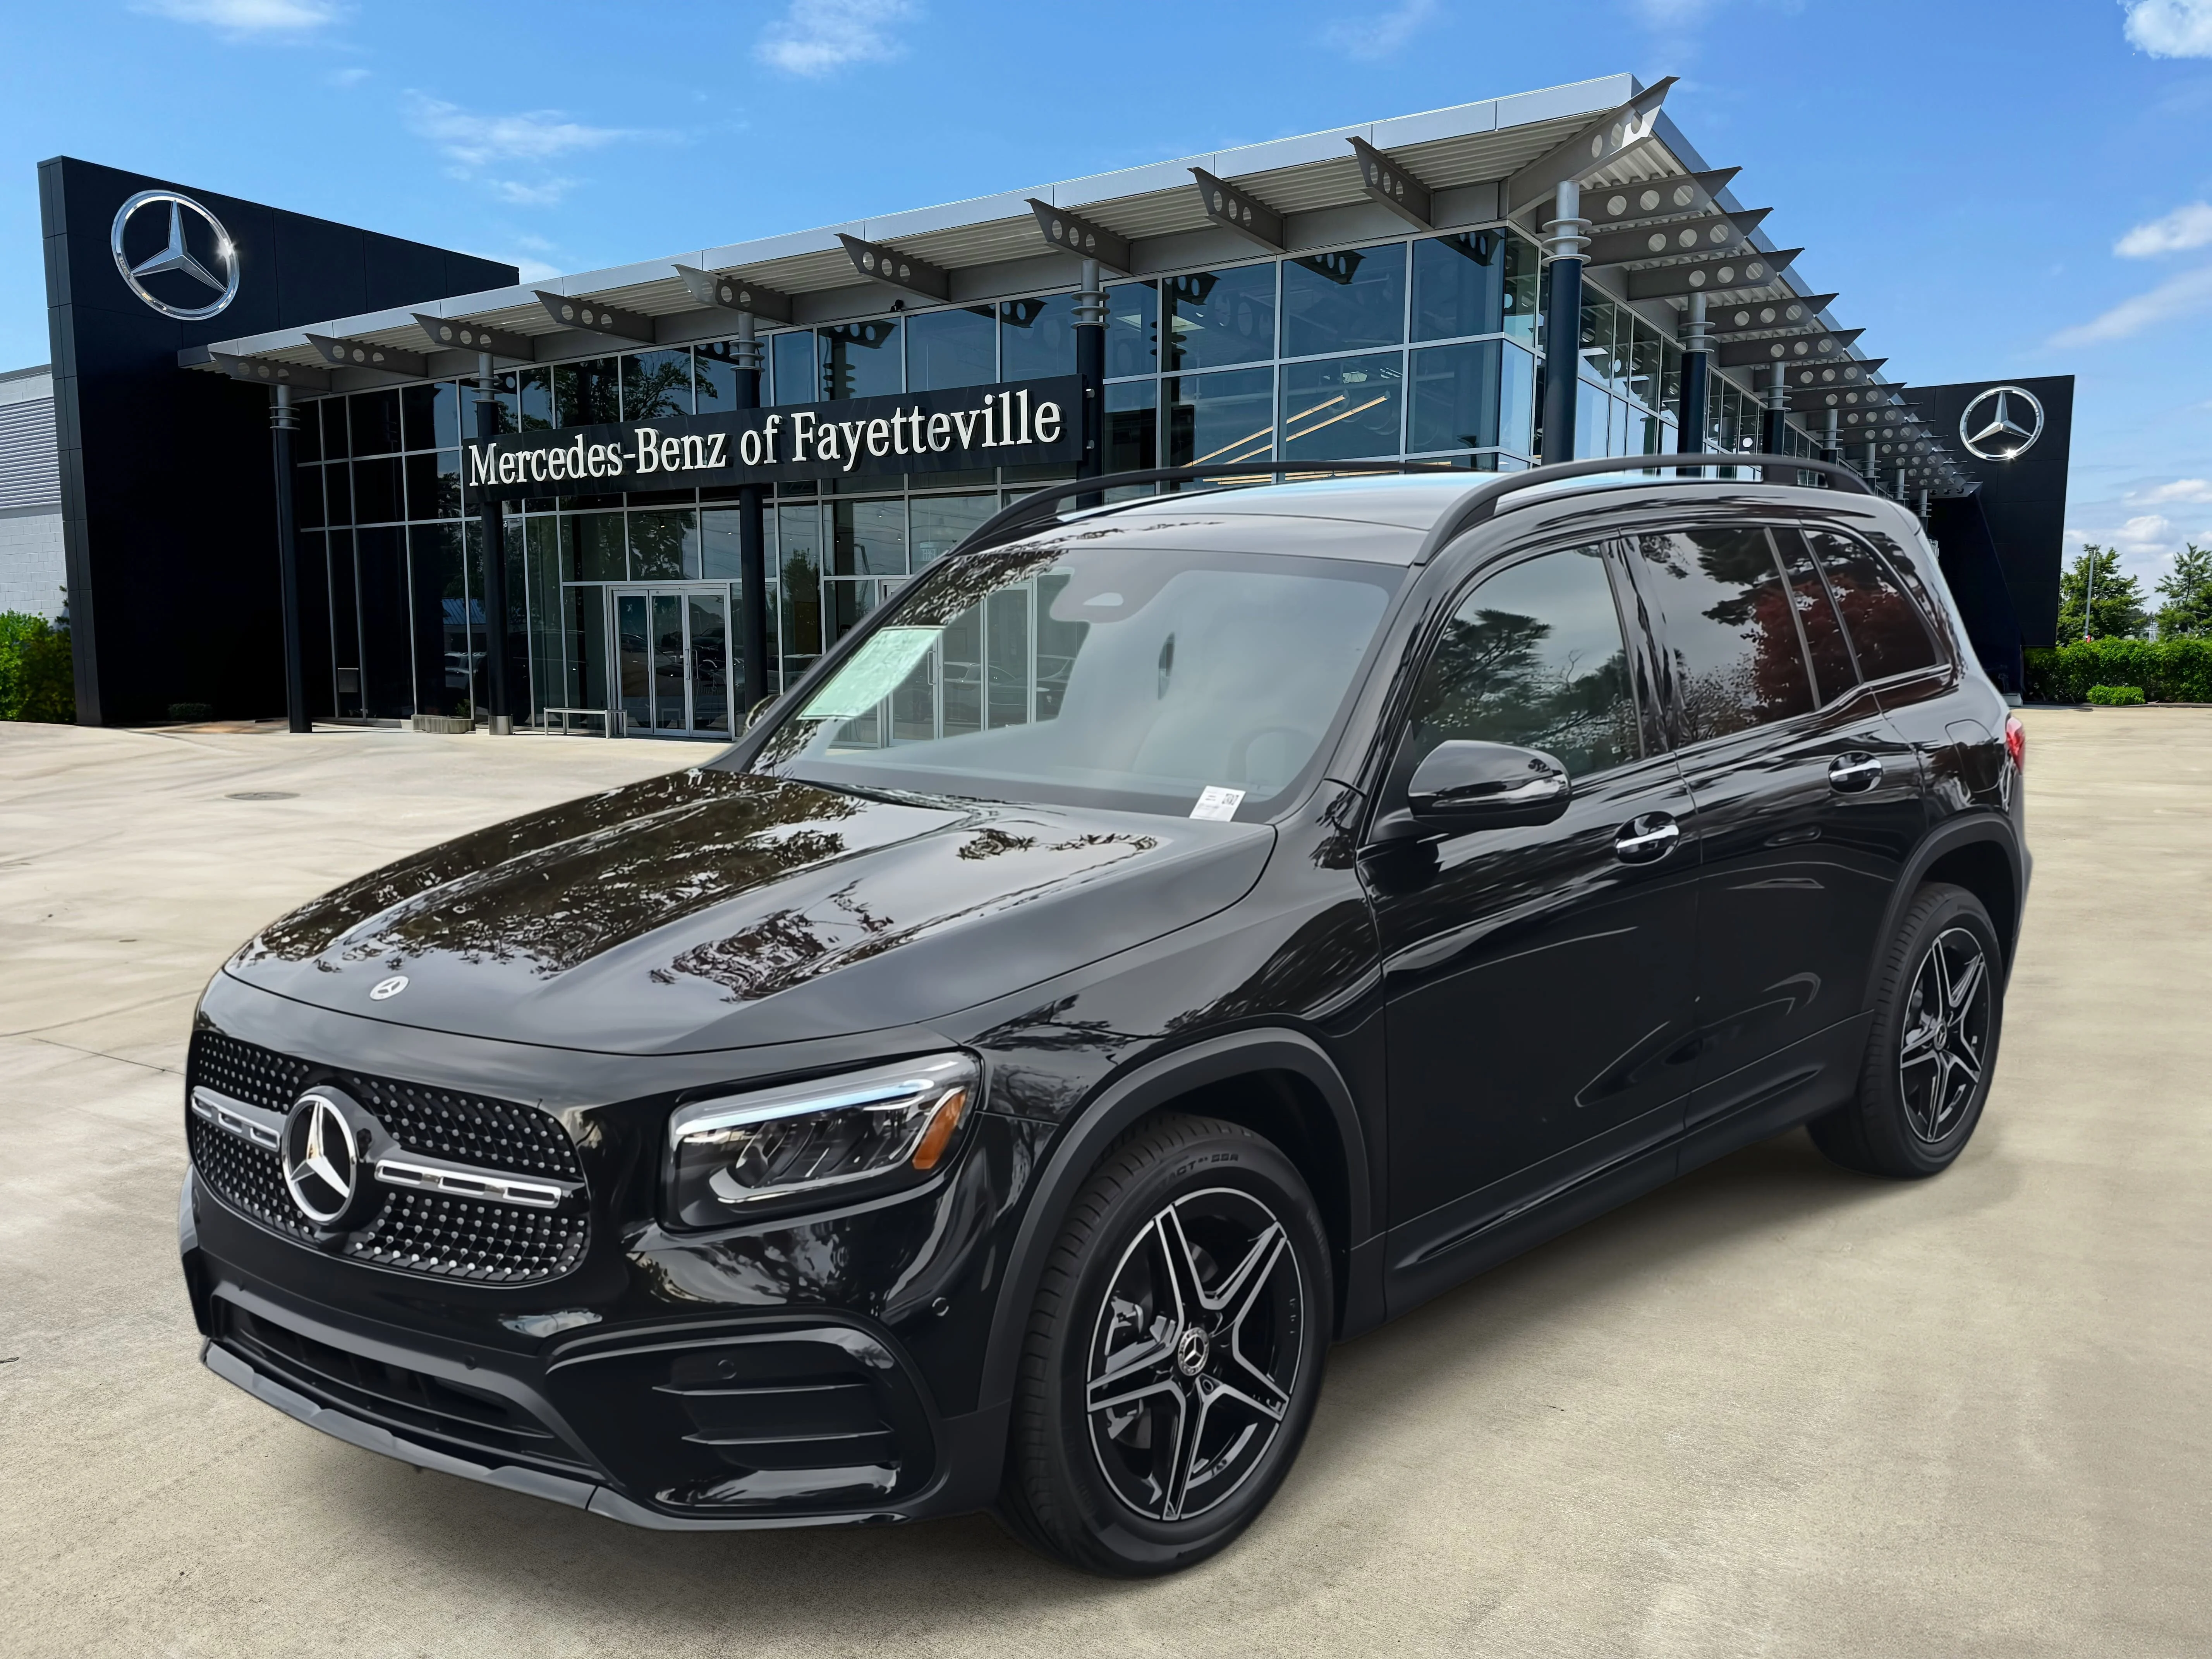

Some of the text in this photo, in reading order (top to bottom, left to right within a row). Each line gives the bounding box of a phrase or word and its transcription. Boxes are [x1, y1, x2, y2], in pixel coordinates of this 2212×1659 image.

[468, 388, 1061, 487] Mercedes-Benz of Fayetteville
